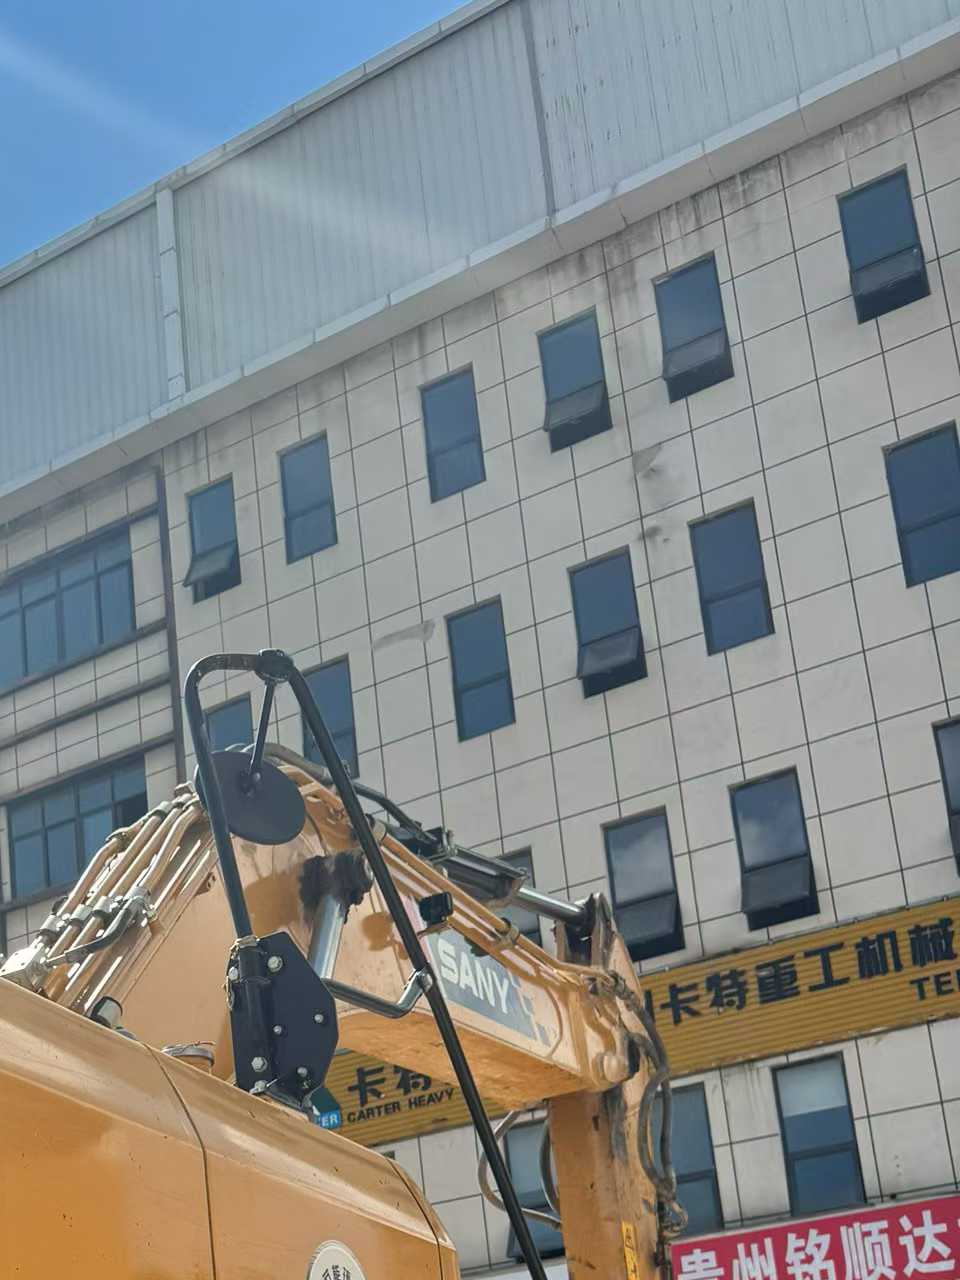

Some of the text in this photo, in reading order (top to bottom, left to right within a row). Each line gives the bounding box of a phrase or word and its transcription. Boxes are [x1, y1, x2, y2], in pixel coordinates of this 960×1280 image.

[437, 937, 509, 1015] SANY
[644, 917, 958, 1026] 卡特重工机械
[908, 970, 960, 1001] TE
[347, 1087, 454, 1123] CARTER HEAVY
